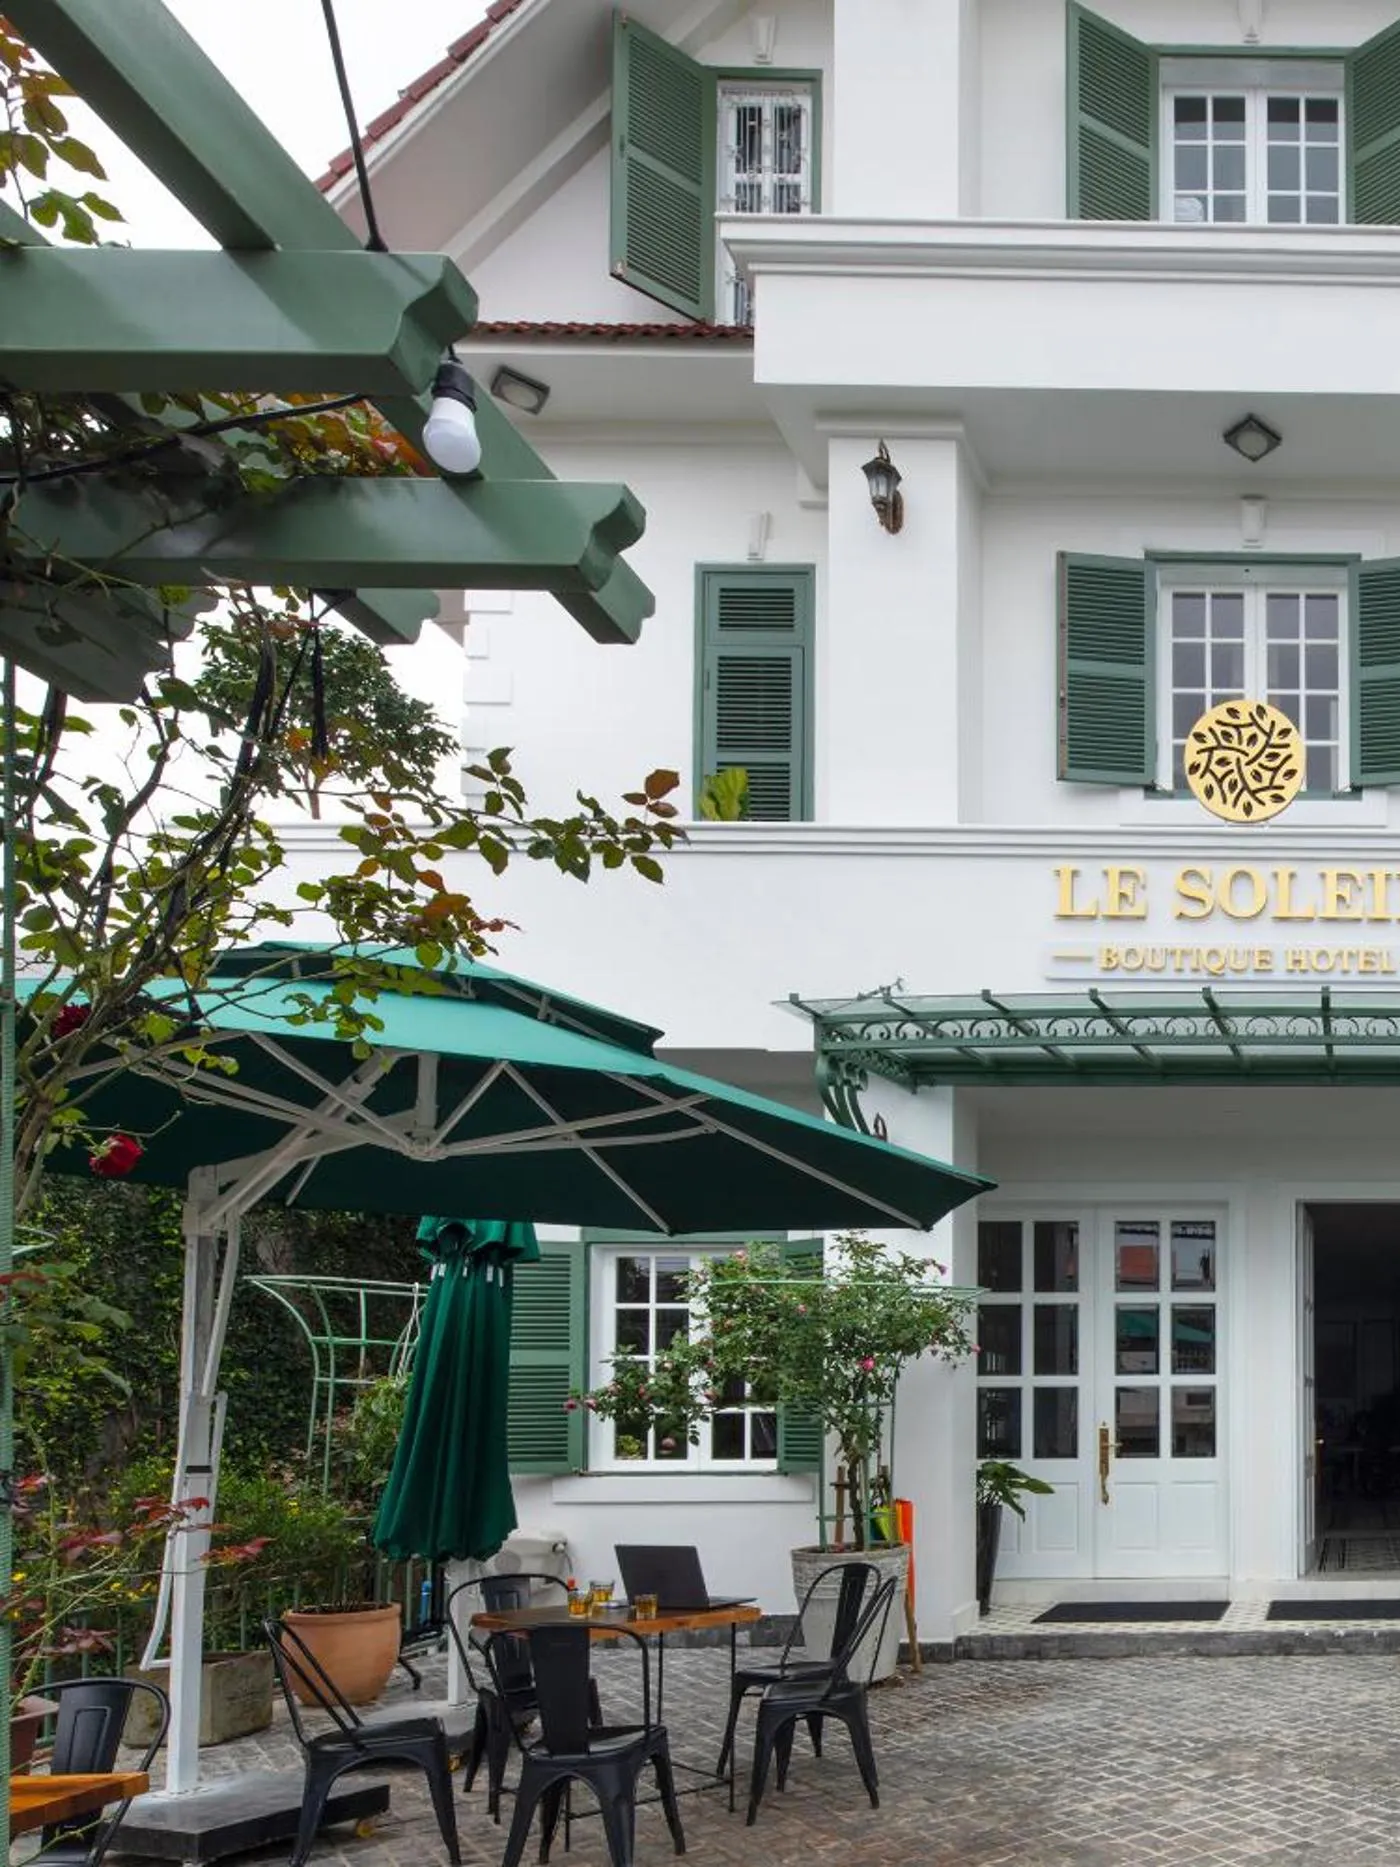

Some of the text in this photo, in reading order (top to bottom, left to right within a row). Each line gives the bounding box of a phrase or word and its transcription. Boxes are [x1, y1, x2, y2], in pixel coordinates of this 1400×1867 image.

[1054, 866, 1147, 920] LE
[1101, 947, 1396, 977] BOUTIQUE HOTEL
